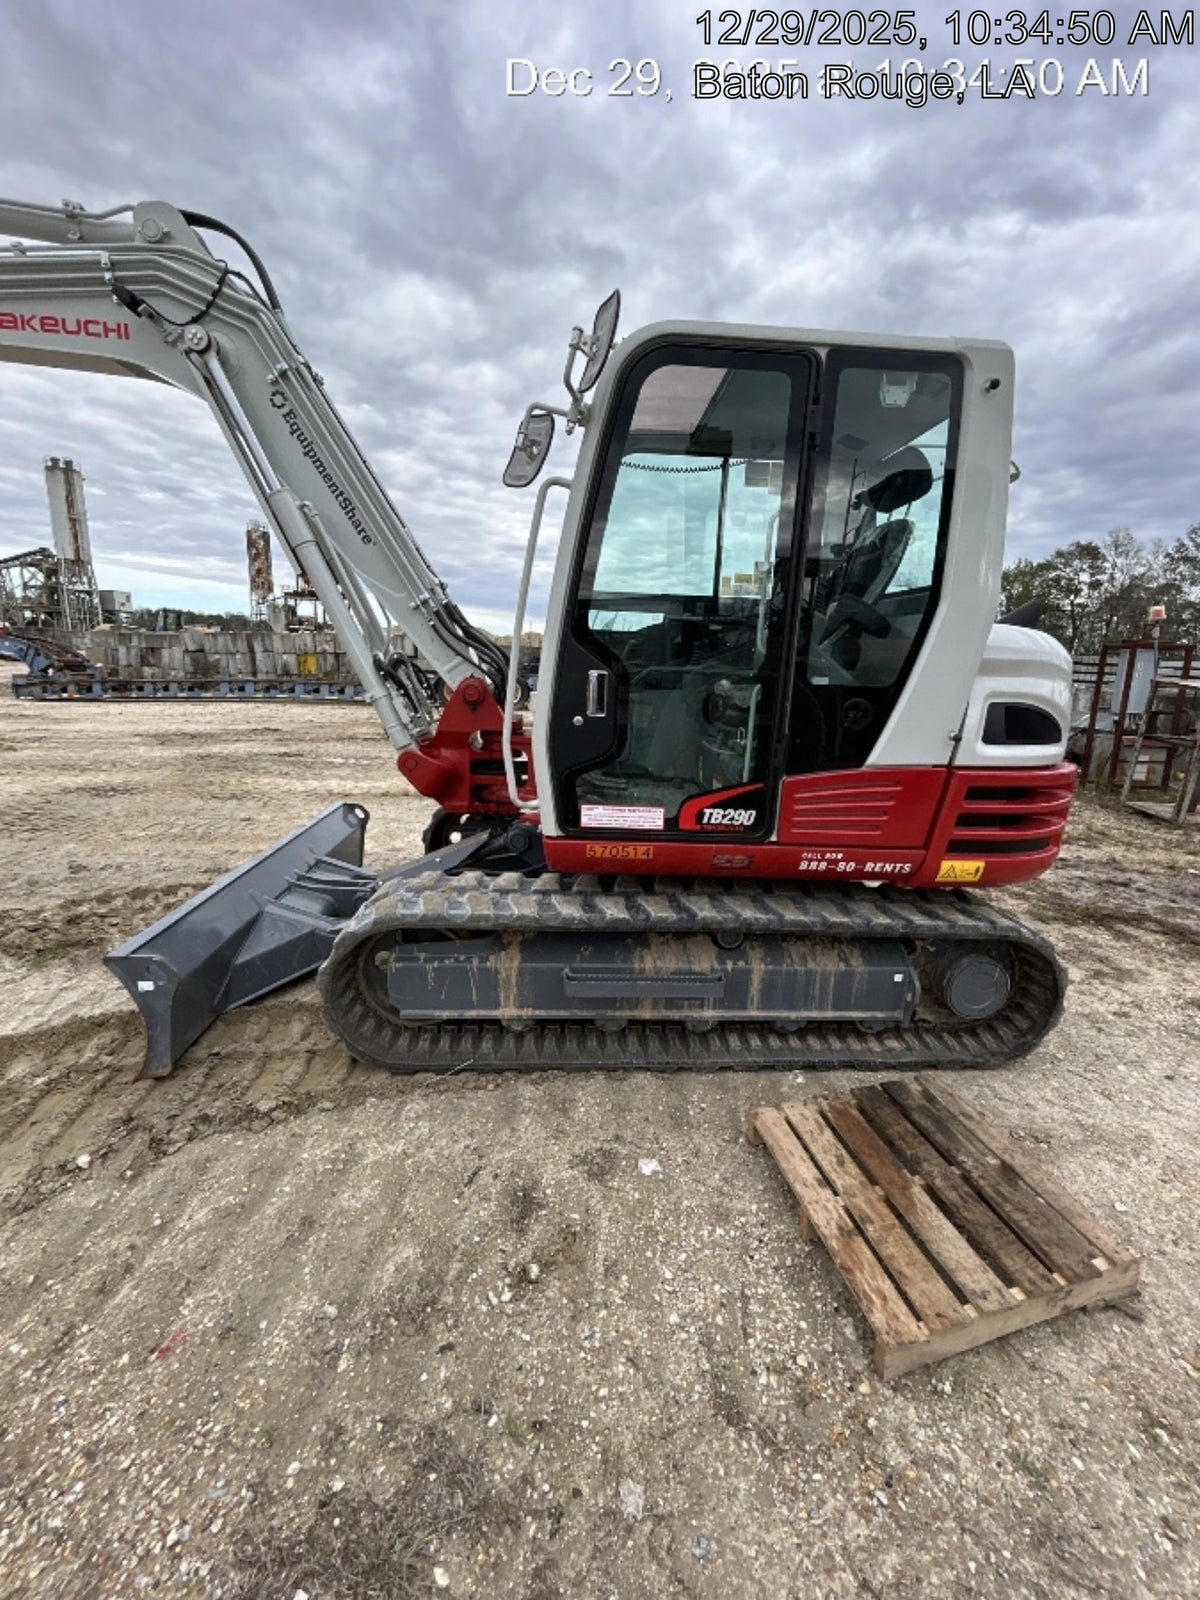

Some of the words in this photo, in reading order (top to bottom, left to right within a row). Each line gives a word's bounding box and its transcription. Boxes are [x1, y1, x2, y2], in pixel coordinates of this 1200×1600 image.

[281, 408, 373, 545] EquipmentShare
[701, 808, 757, 826] TB290
[587, 845, 652, 859] 570514
